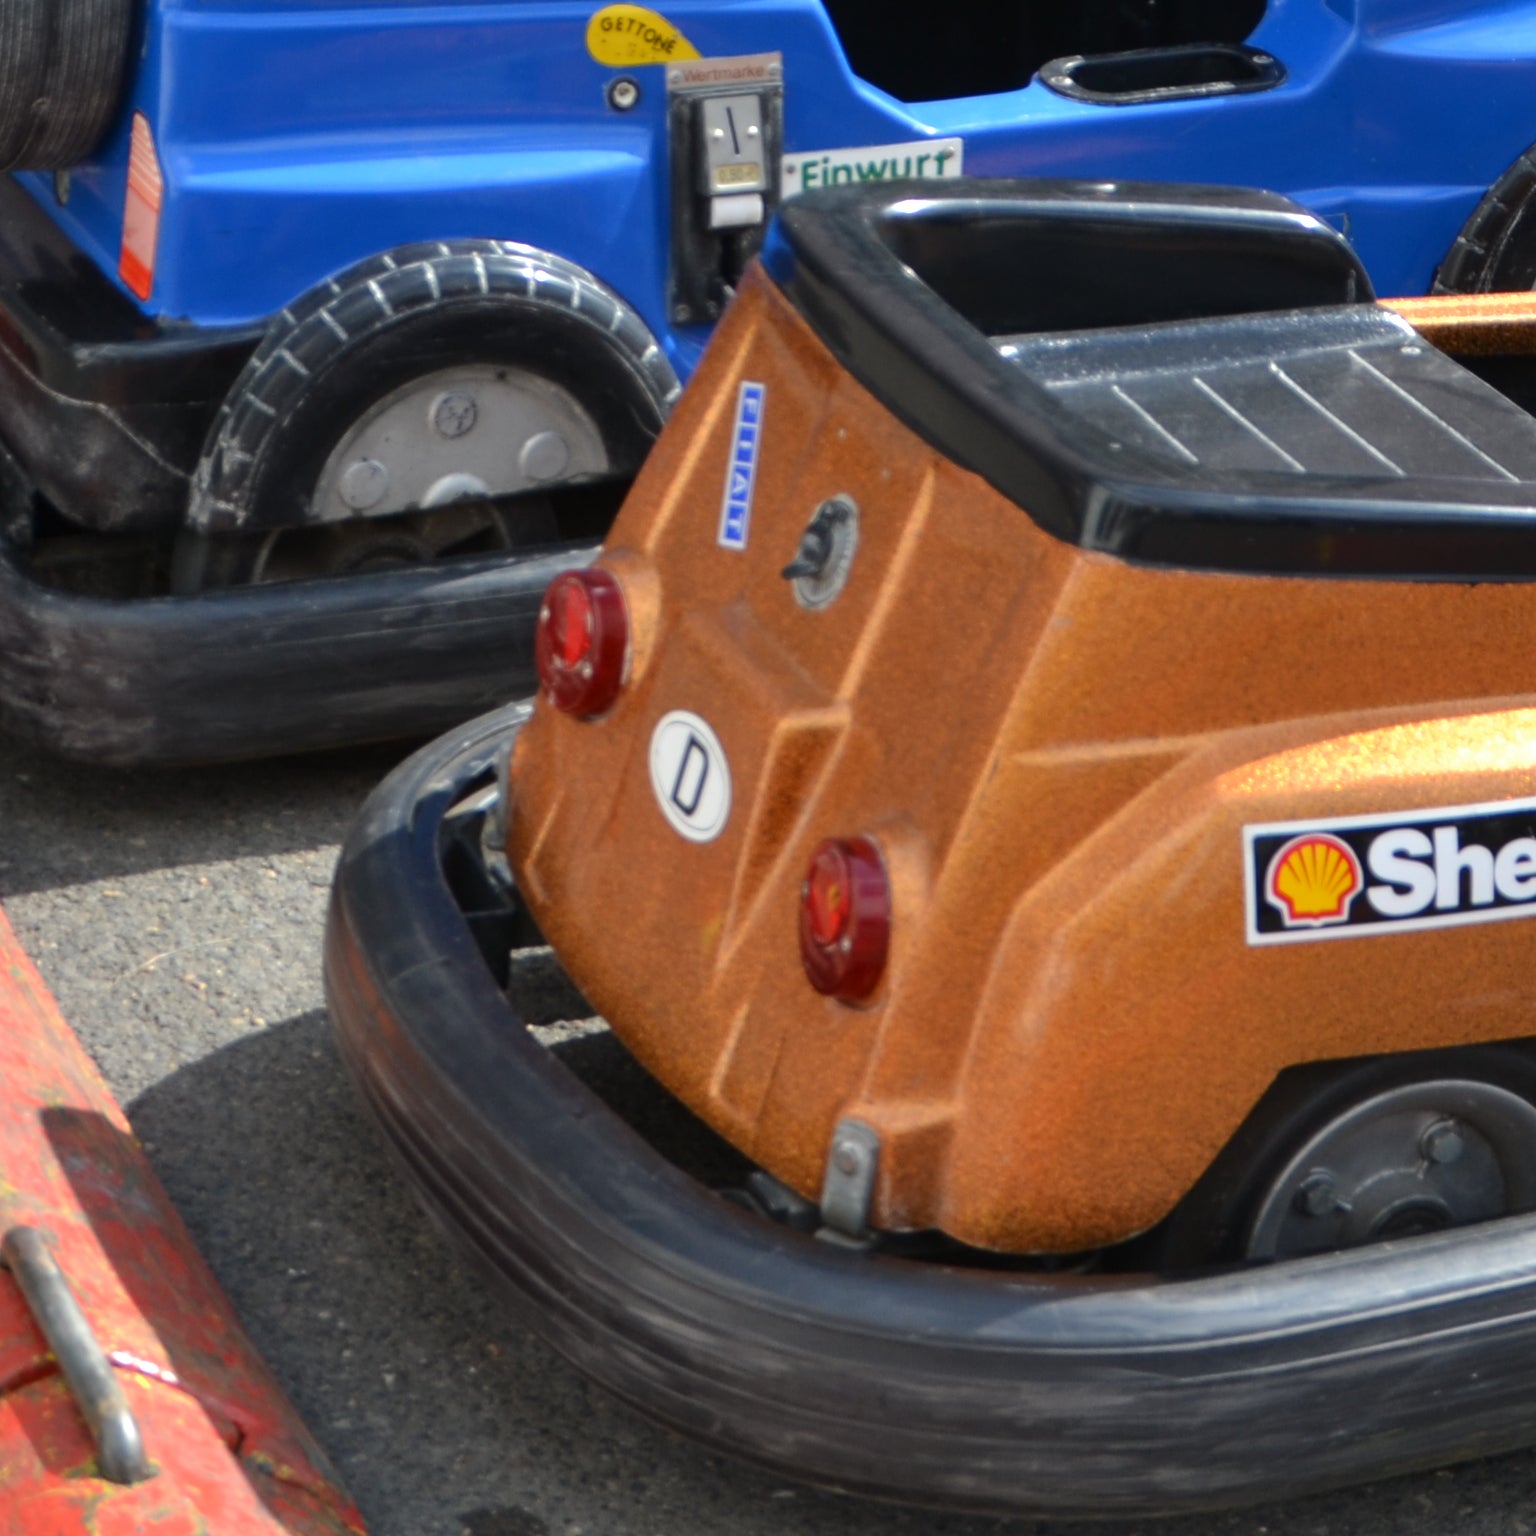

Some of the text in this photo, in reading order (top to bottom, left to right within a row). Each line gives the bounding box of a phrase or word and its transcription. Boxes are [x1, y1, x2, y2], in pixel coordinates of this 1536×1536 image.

[600, 16, 677, 55] GETTONE
[683, 64, 765, 83] Wertmarke
[800, 152, 949, 191] Einwurf
